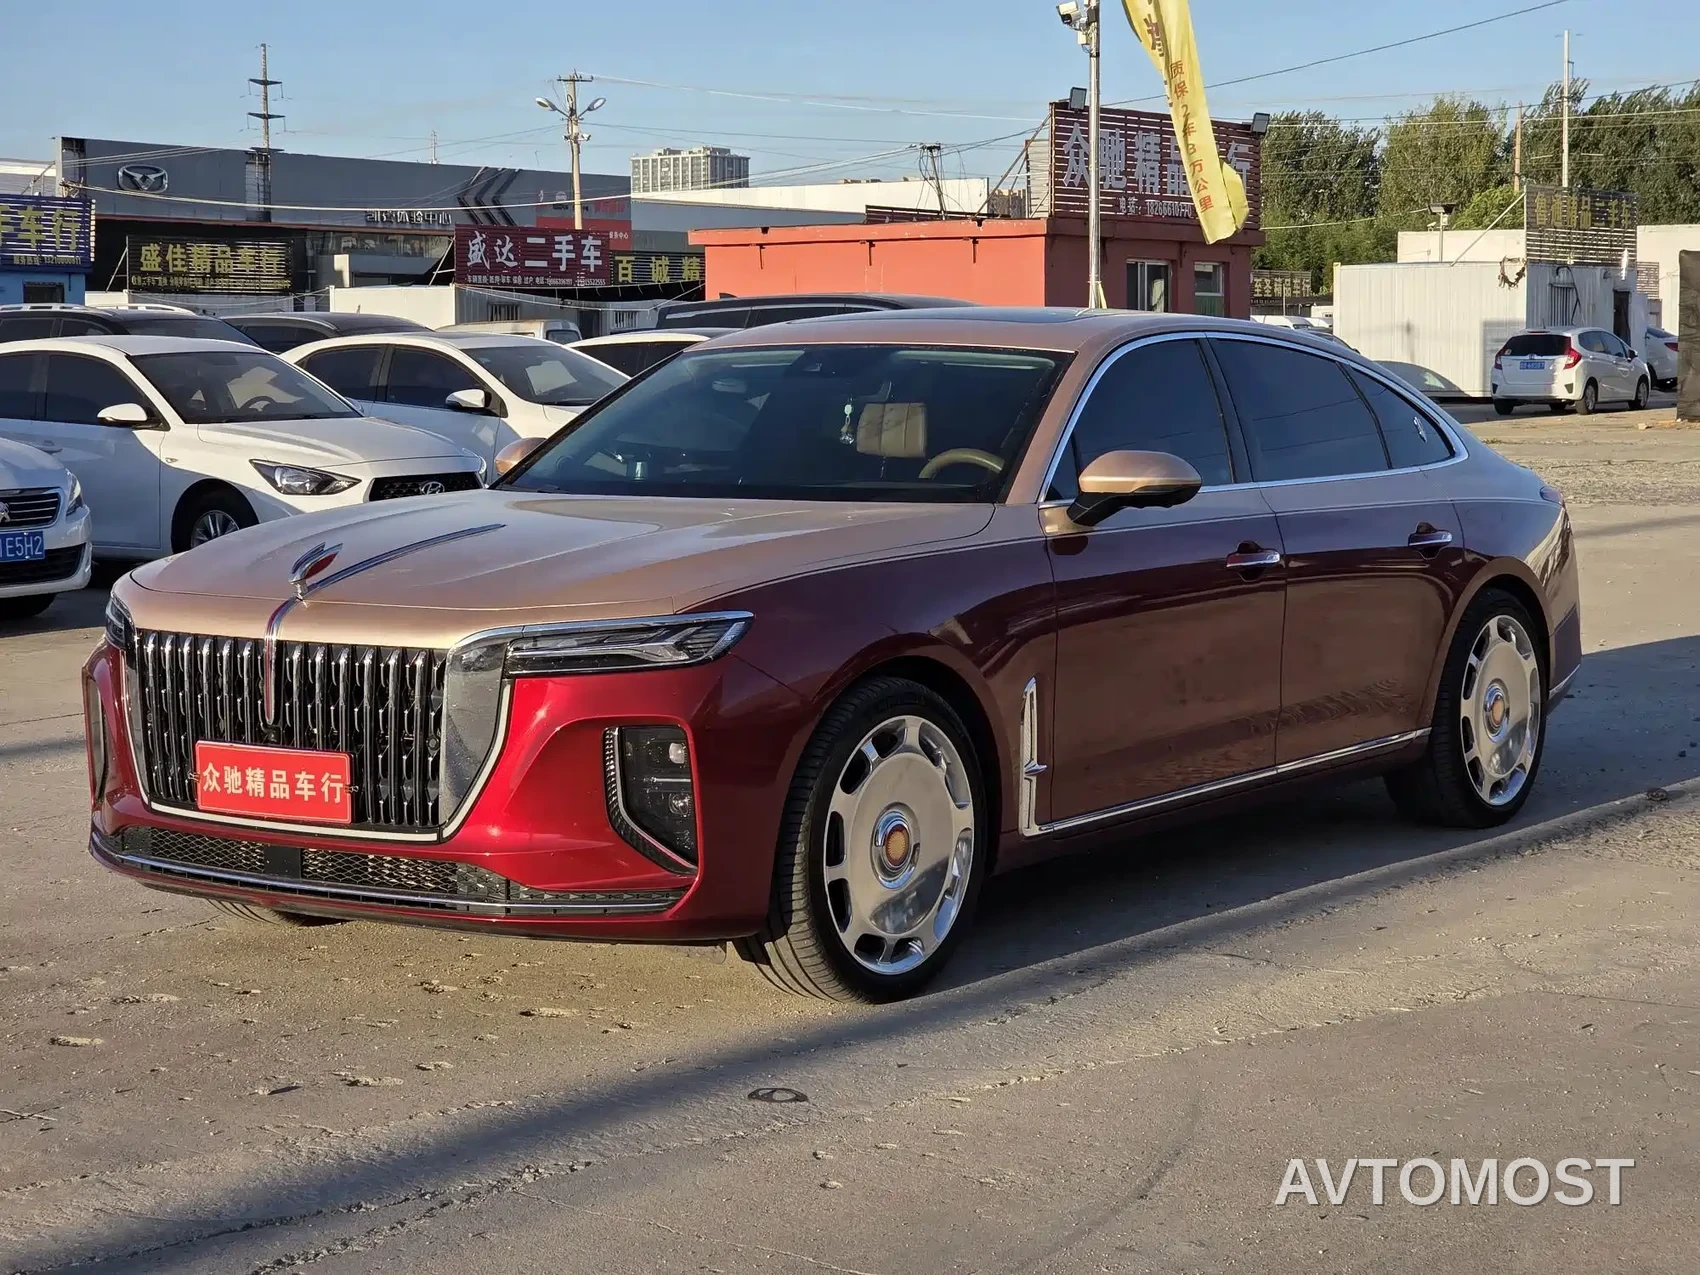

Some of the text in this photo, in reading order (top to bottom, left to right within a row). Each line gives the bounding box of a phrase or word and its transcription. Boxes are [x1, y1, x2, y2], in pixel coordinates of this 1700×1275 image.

[1063, 121, 1252, 195] 众驰精品行
[140, 243, 281, 275] 盛佳精品车行
[467, 230, 603, 273] 盛达二手车
[615, 255, 700, 283] 百诚精
[0, 536, 43, 558] E5H2
[202, 762, 344, 804] 众驰精品车行
